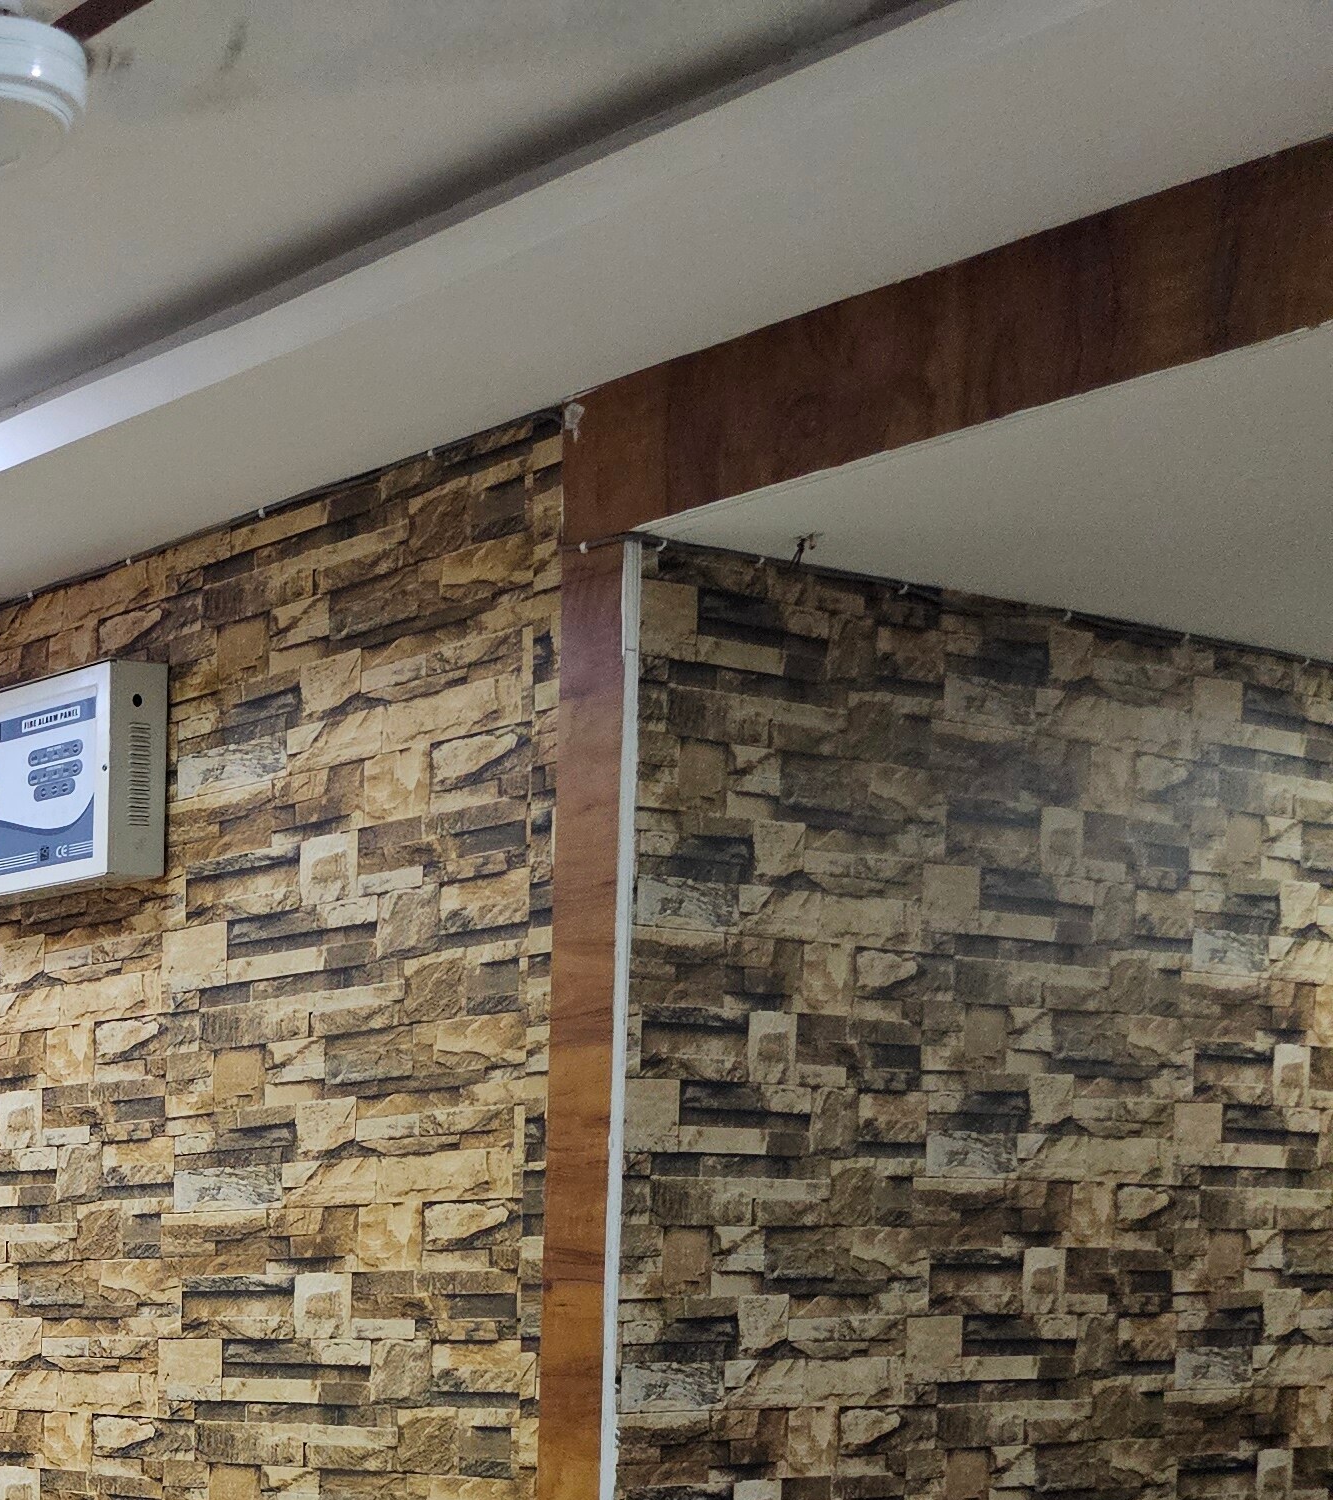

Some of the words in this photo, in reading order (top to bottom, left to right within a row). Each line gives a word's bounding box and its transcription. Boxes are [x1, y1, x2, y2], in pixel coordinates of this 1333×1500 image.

[24, 719, 37, 730] FIRE
[38, 713, 59, 726] ALARM
[60, 708, 79, 720] PANEL
